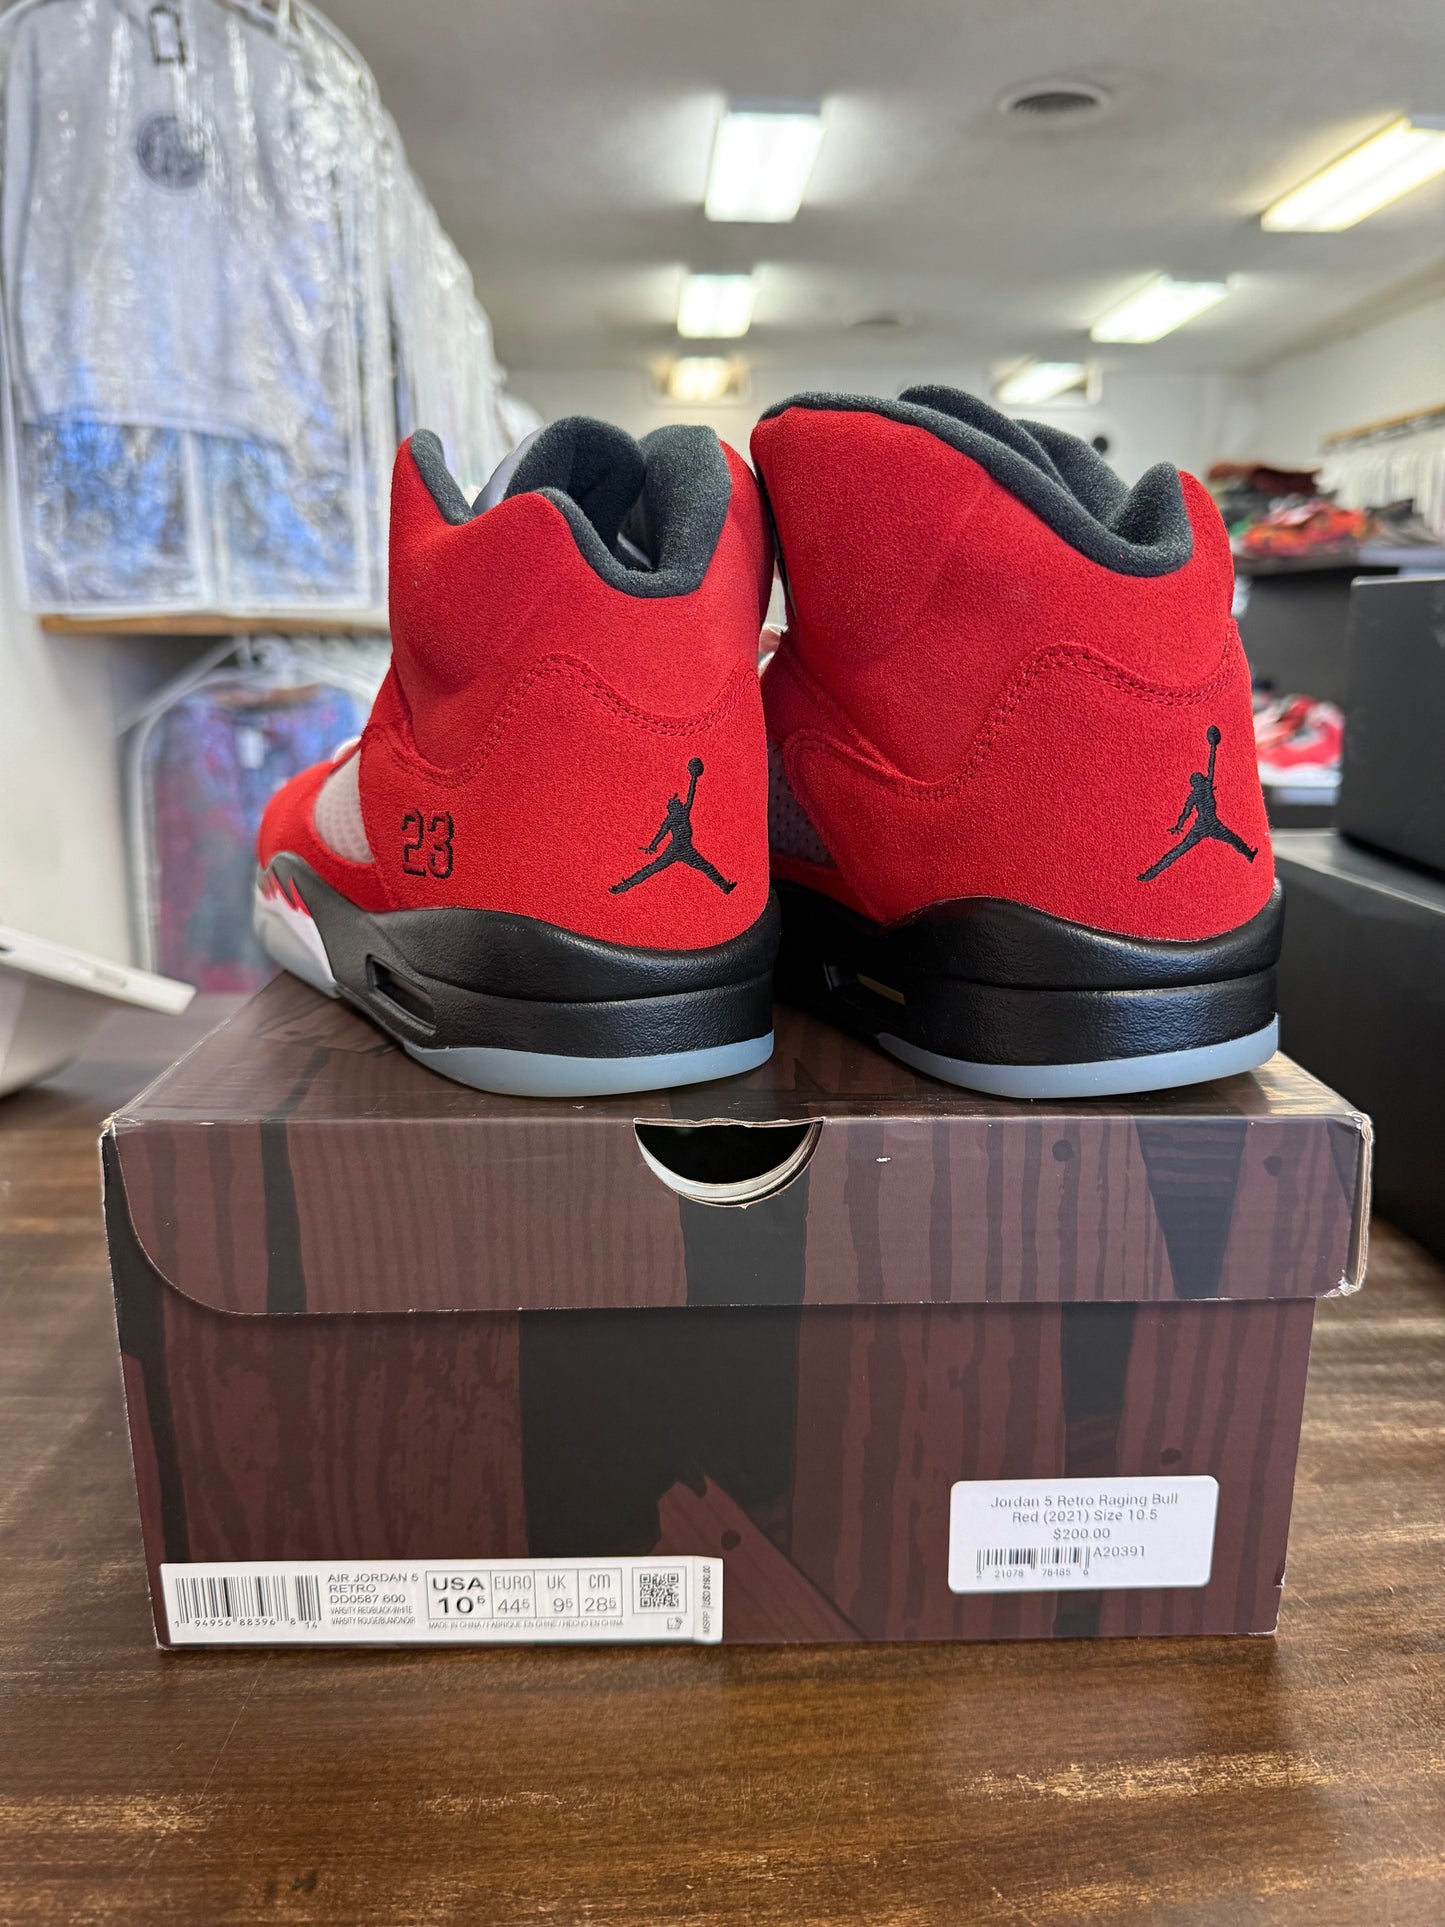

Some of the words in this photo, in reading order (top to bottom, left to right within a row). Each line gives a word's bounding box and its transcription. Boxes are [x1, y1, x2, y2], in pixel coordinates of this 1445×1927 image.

[401, 809, 455, 879] 23
[990, 1495, 1039, 1508] Jordan
[1045, 1496, 1052, 1507] 5
[1057, 1495, 1095, 1506] Retro
[1099, 1493, 1148, 1508] Raging
[1152, 1493, 1179, 1504] Bull
[1012, 1510, 1038, 1523] Red
[1043, 1509, 1089, 1525] (2021)
[1094, 1509, 1123, 1521] Size
[1128, 1508, 1158, 1521] 10.5
[1052, 1527, 1110, 1541] $200.00
[1093, 1545, 1146, 1558] A20391
[327, 1573, 350, 1583] AIR
[353, 1573, 407, 1583] JORDAN
[411, 1573, 419, 1582] 5
[994, 1569, 1024, 1578] 21078
[329, 1583, 376, 1593] RETRO
[432, 1576, 485, 1591] USA
[494, 1575, 532, 1590] EURO
[546, 1574, 567, 1590] UK
[330, 1594, 379, 1604] DD0587
[382, 1594, 406, 1604] 600
[195, 1619, 232, 1628] 94956
[239, 1618, 276, 1627] 88396
